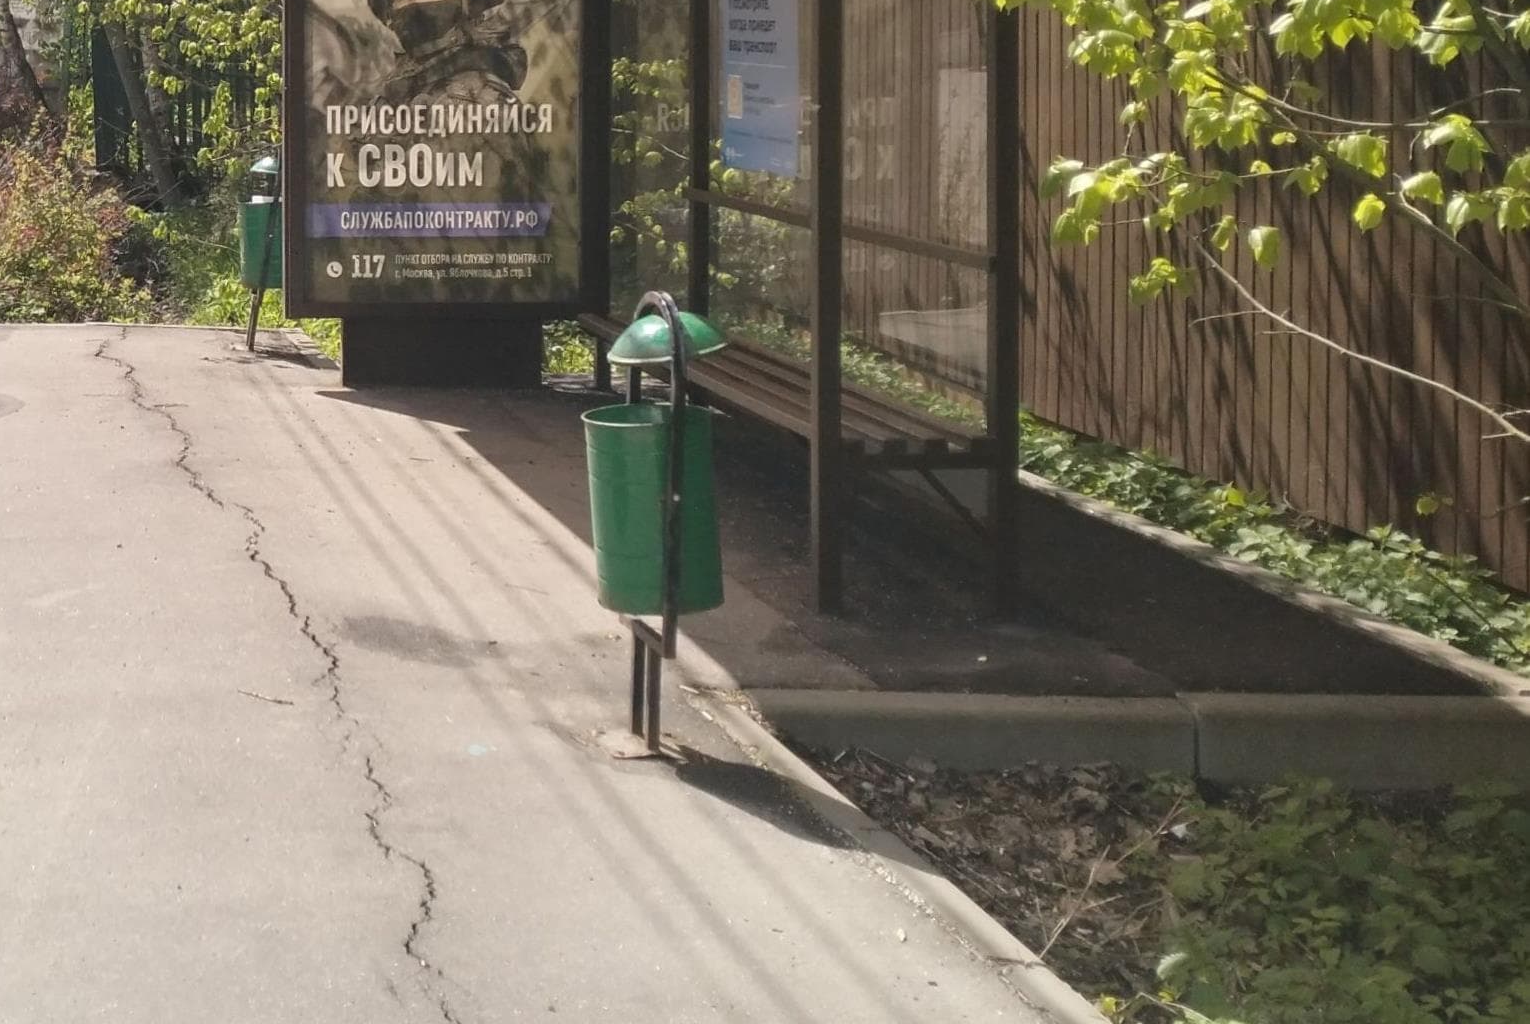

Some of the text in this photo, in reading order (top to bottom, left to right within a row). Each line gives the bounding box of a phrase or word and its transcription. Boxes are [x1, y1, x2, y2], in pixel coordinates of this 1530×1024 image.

[326, 97, 552, 137] ПРИСОЕДИНЯЙСЯ
[340, 210, 538, 229] СЛУЖБАПОКОНТРАКТУ.РФ
[351, 255, 385, 278] 117
